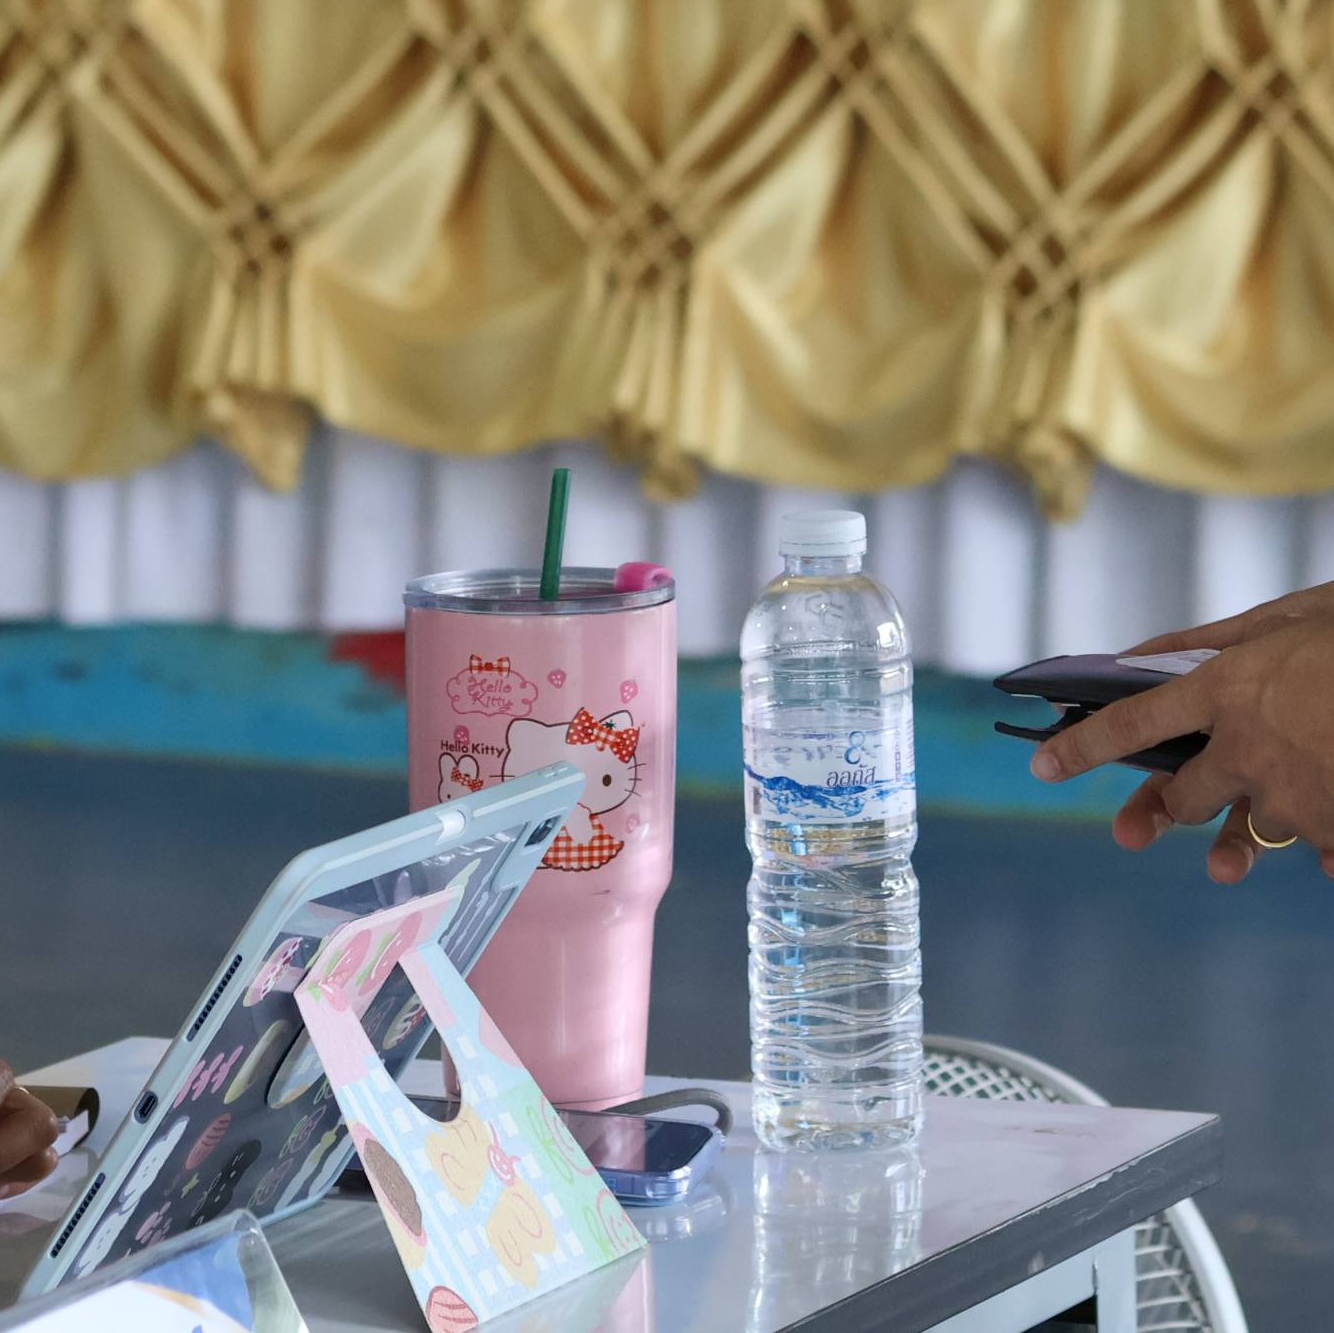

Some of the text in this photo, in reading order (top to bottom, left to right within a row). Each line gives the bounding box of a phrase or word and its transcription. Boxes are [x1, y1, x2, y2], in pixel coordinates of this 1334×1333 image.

[468, 676, 512, 697] Hello
[470, 692, 513, 713] Kitty
[440, 740, 505, 758] Hello Kitty
